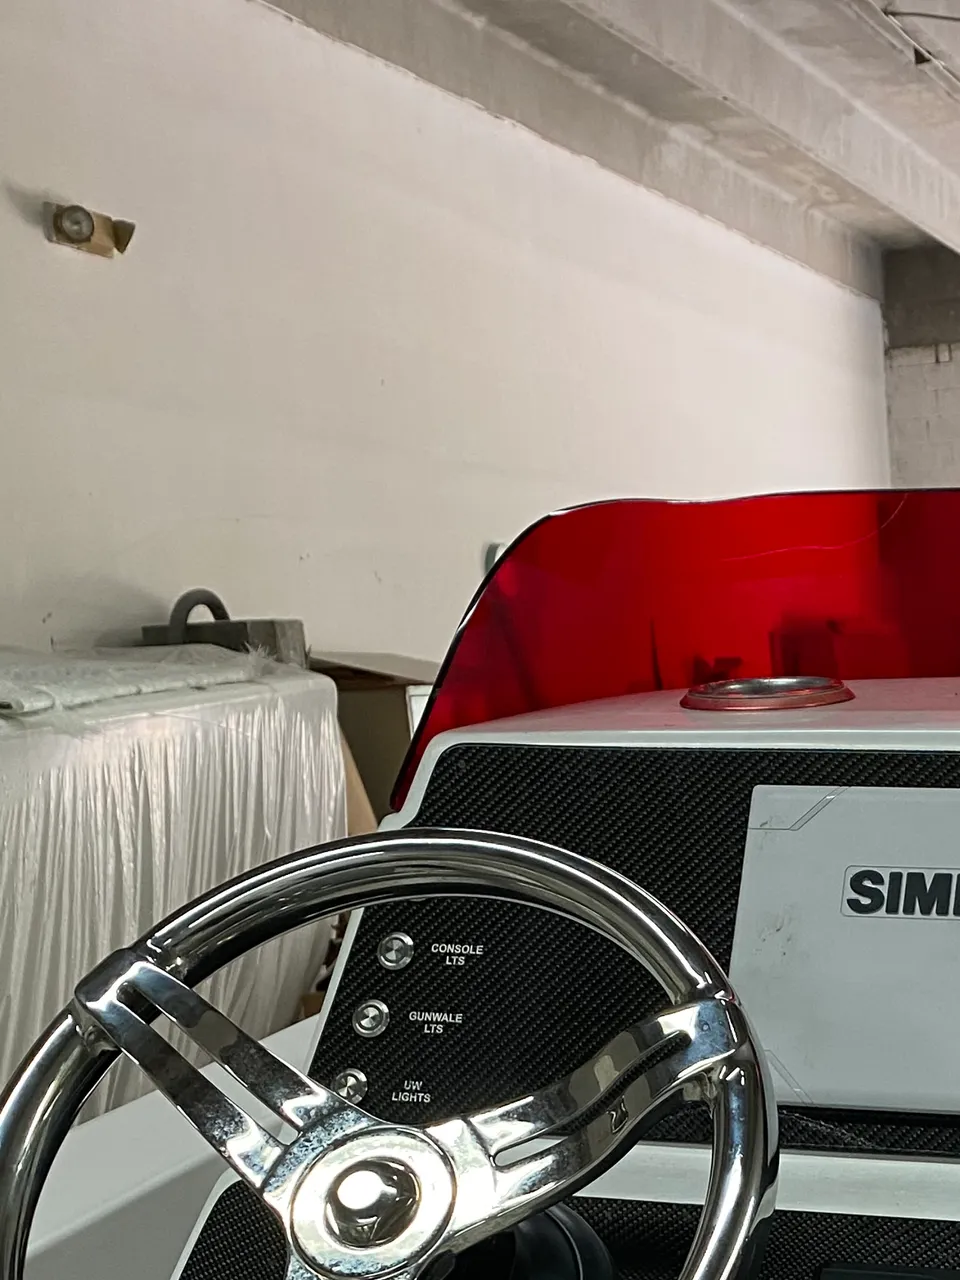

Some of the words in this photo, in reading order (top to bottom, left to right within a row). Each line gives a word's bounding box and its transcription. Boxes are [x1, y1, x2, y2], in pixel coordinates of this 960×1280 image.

[431, 943, 484, 955] CONSOLE
[445, 956, 466, 966] LTS
[408, 1011, 463, 1023] GUNWALE
[423, 1024, 444, 1034] LTS
[404, 1080, 423, 1091] UW
[391, 1092, 431, 1103] LIGHTS
